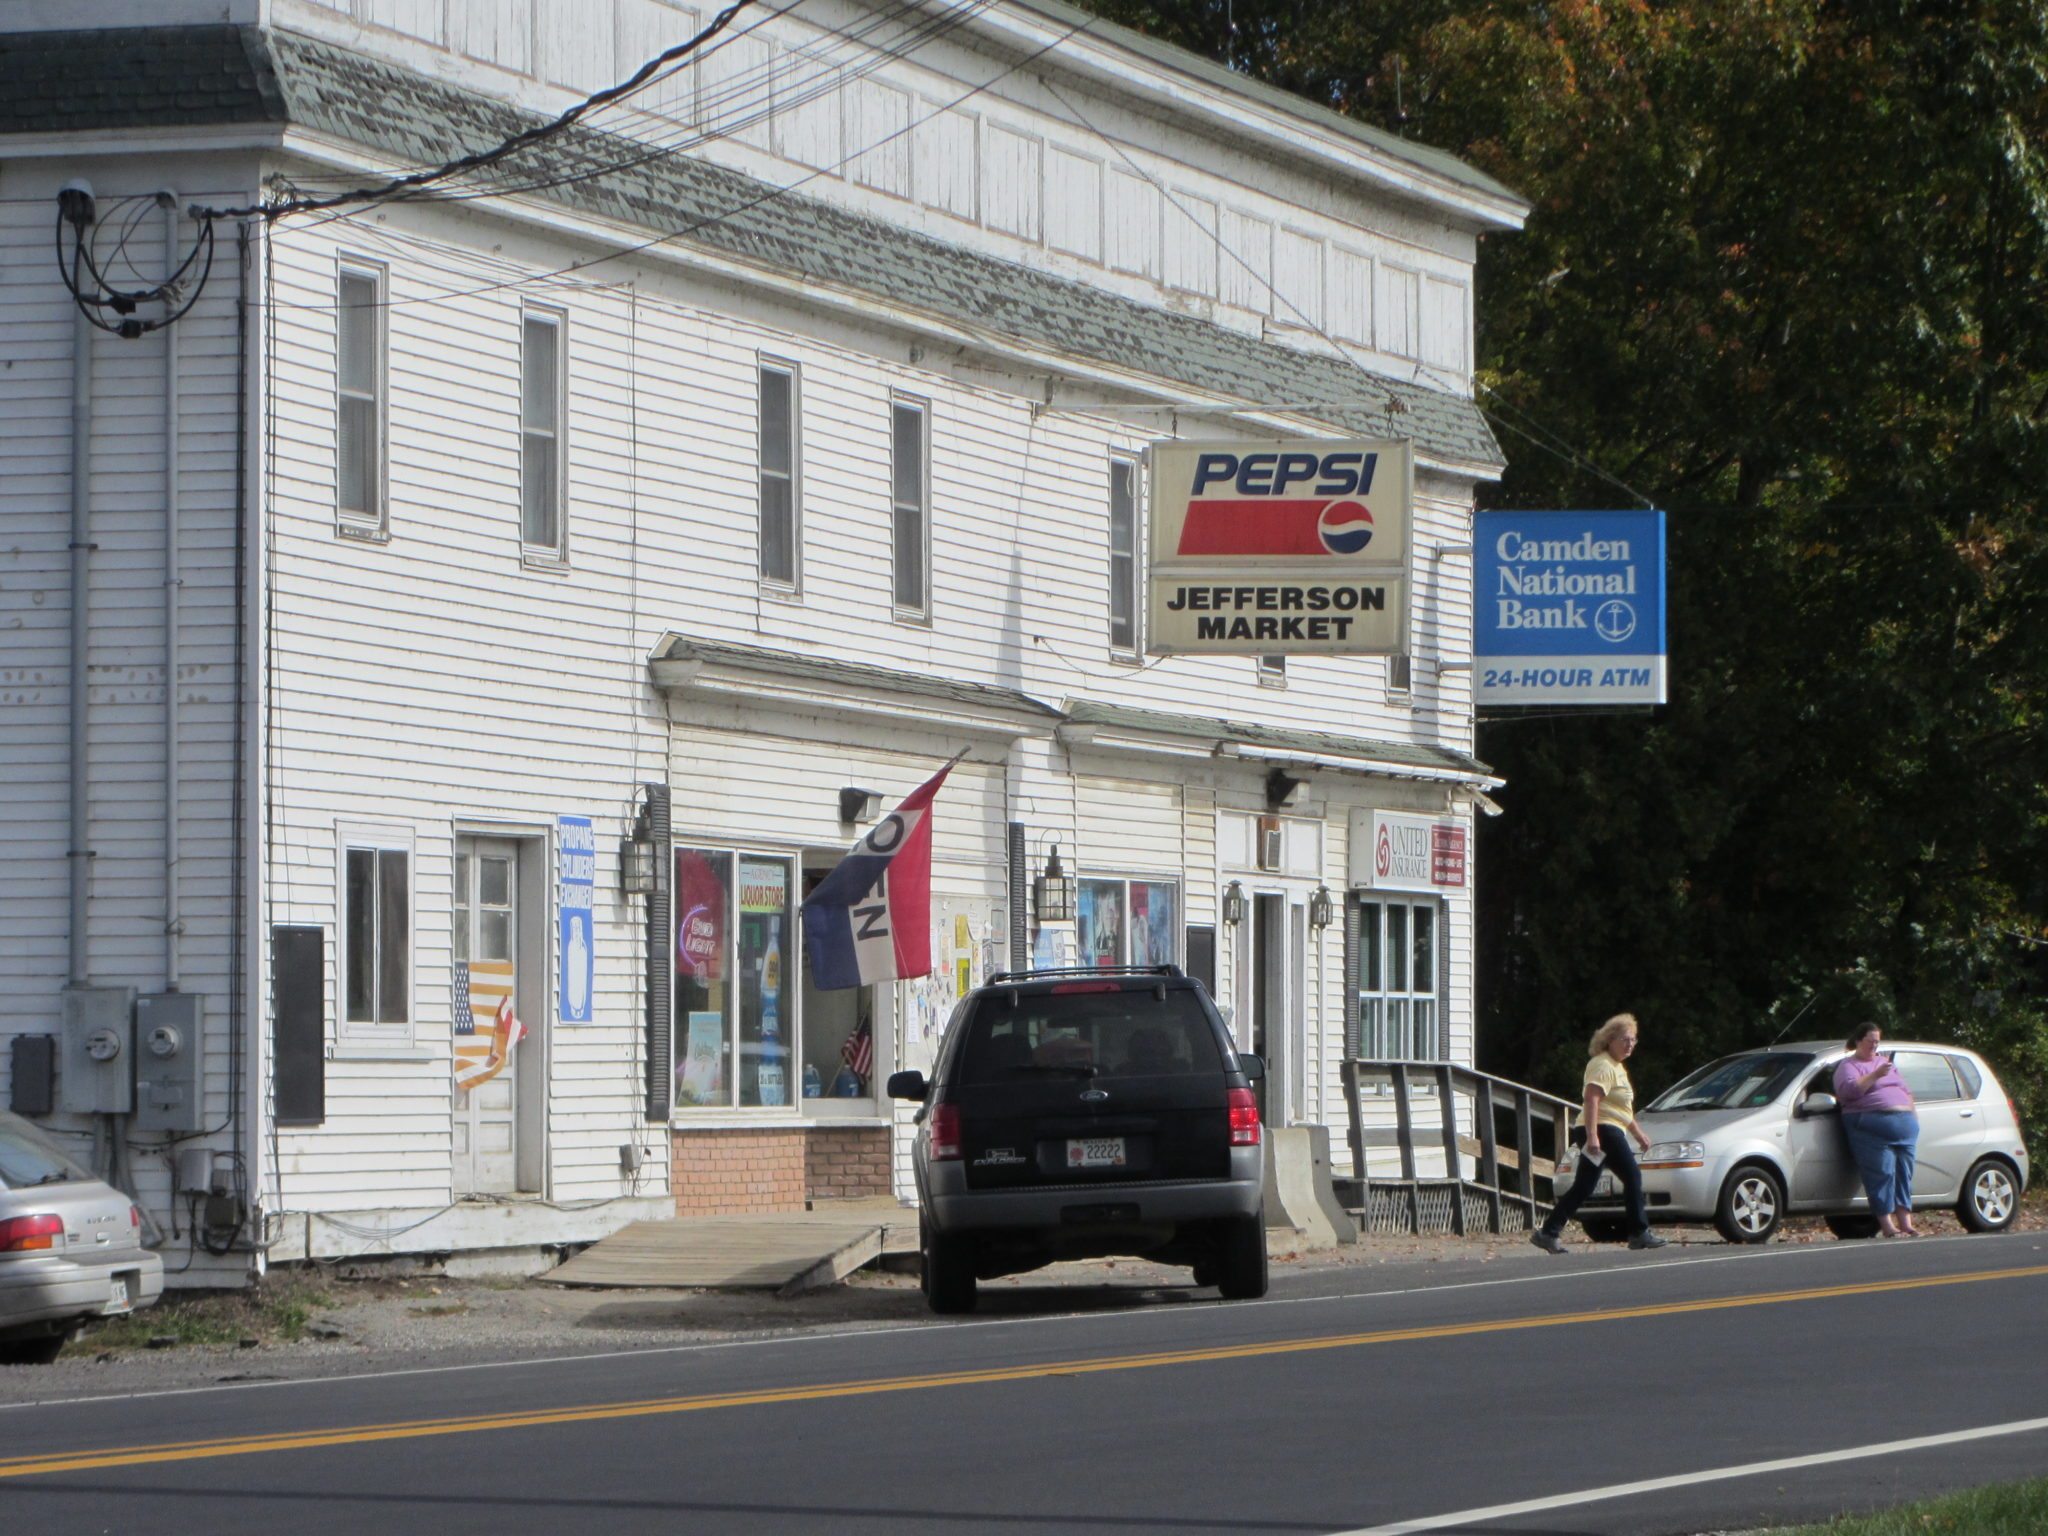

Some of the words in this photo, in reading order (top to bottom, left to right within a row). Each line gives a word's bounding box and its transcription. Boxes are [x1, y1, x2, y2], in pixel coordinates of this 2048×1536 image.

[1191, 452, 1378, 496] PEPSI
[1496, 531, 1630, 562] Camden
[1496, 564, 1637, 596] National
[1167, 586, 1385, 611] JEFFERSON
[1496, 599, 1588, 630] Bank
[1198, 616, 1353, 641] MARKET
[1483, 668, 1593, 687] 24-HOUR
[1599, 667, 1651, 687] ATM
[560, 824, 593, 850] PROPANE
[1391, 825, 1428, 857] UNITED
[560, 853, 593, 880] CYLINDERS
[1391, 857, 1427, 879] INSURANCE
[740, 884, 764, 908] LIQUOR
[764, 885, 784, 908] STORE
[1087, 1143, 1121, 1160] 22222
